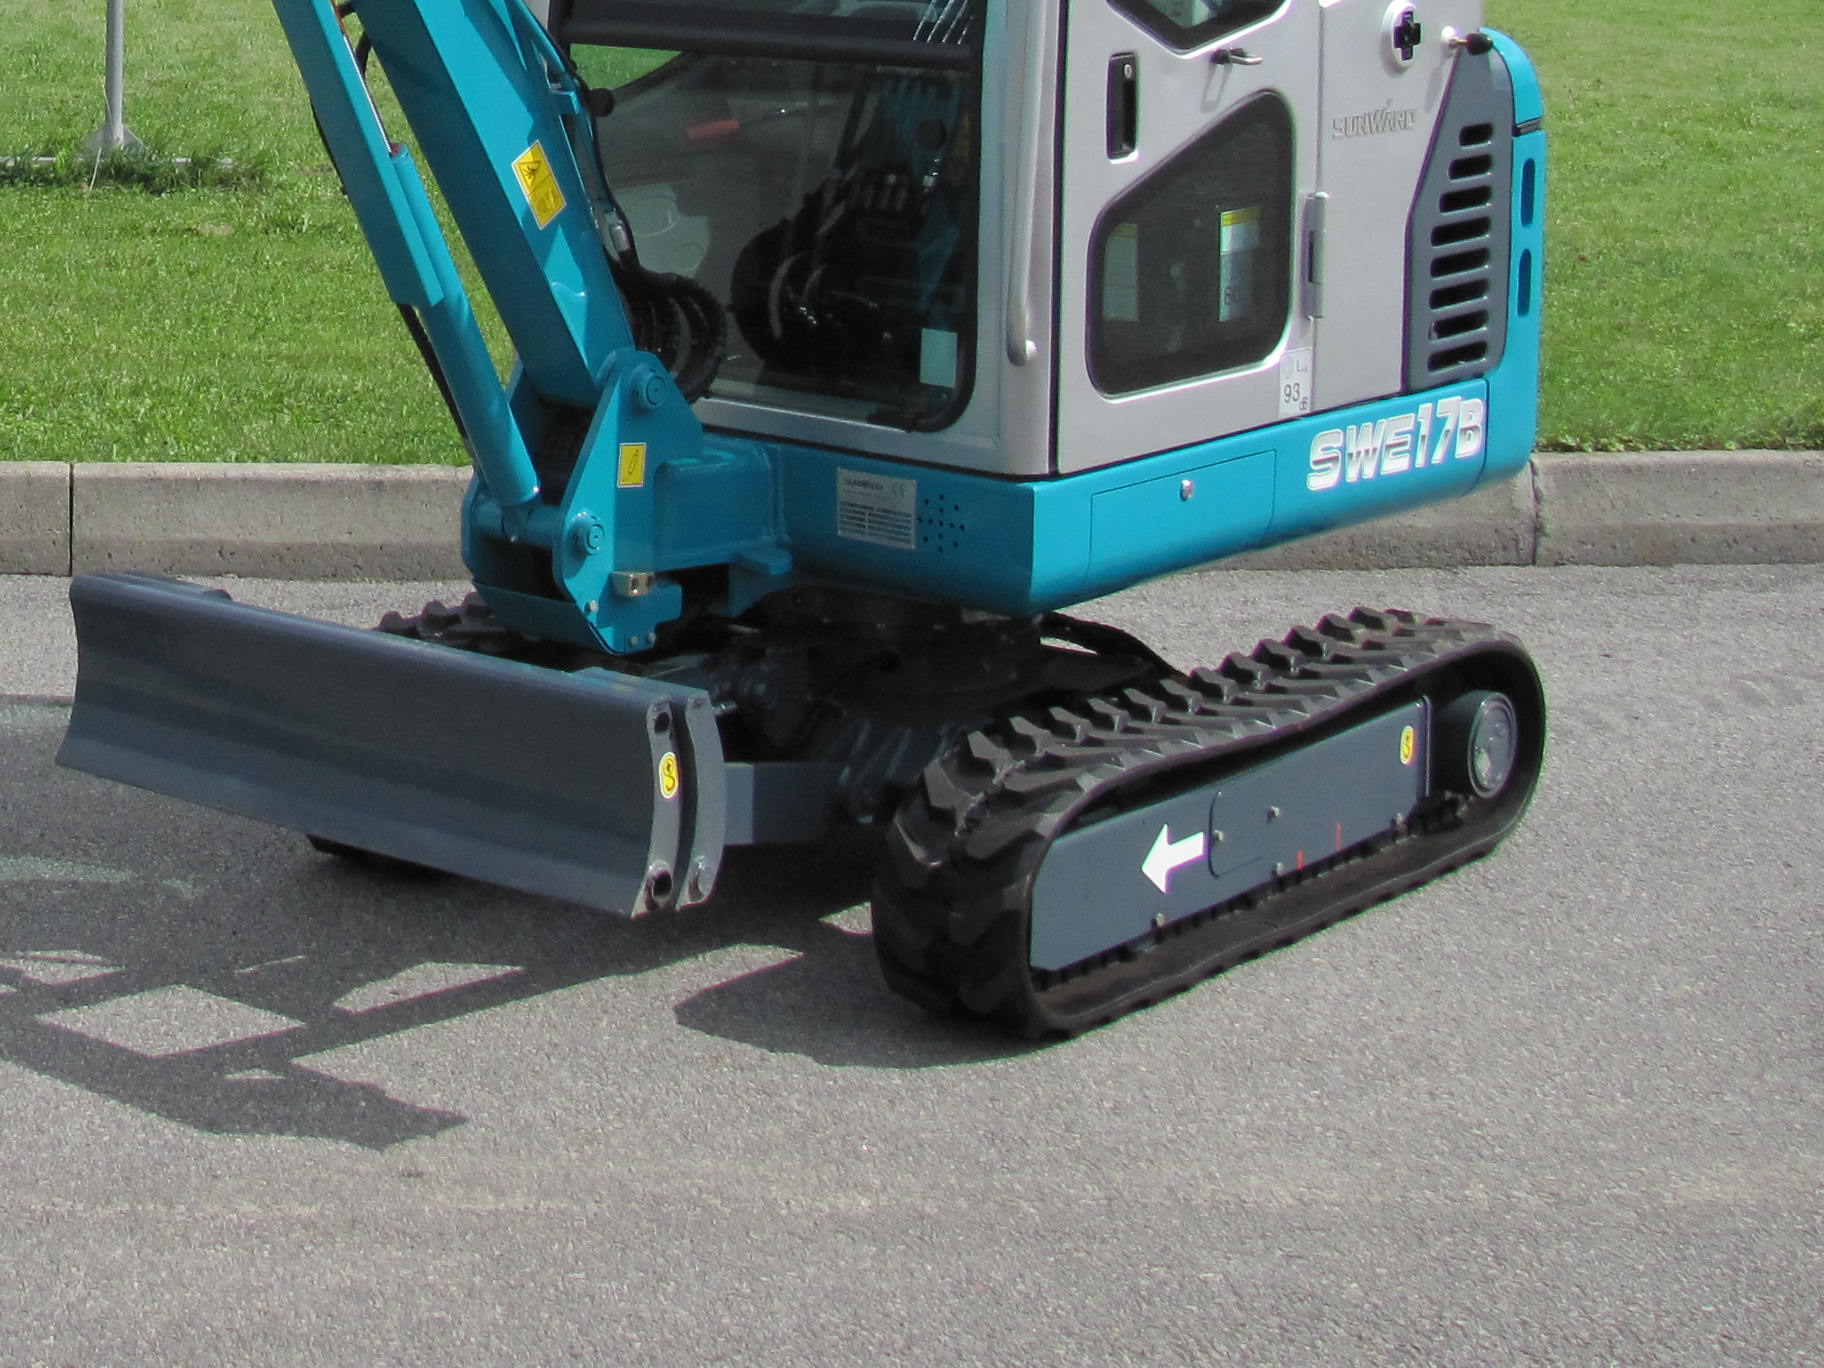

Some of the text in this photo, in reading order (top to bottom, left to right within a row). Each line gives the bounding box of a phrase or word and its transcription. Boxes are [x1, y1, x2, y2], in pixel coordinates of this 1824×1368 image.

[1331, 98, 1417, 140] SUNWARD
[1284, 382, 1300, 403] 93
[1306, 395, 1485, 491] SWE17B
